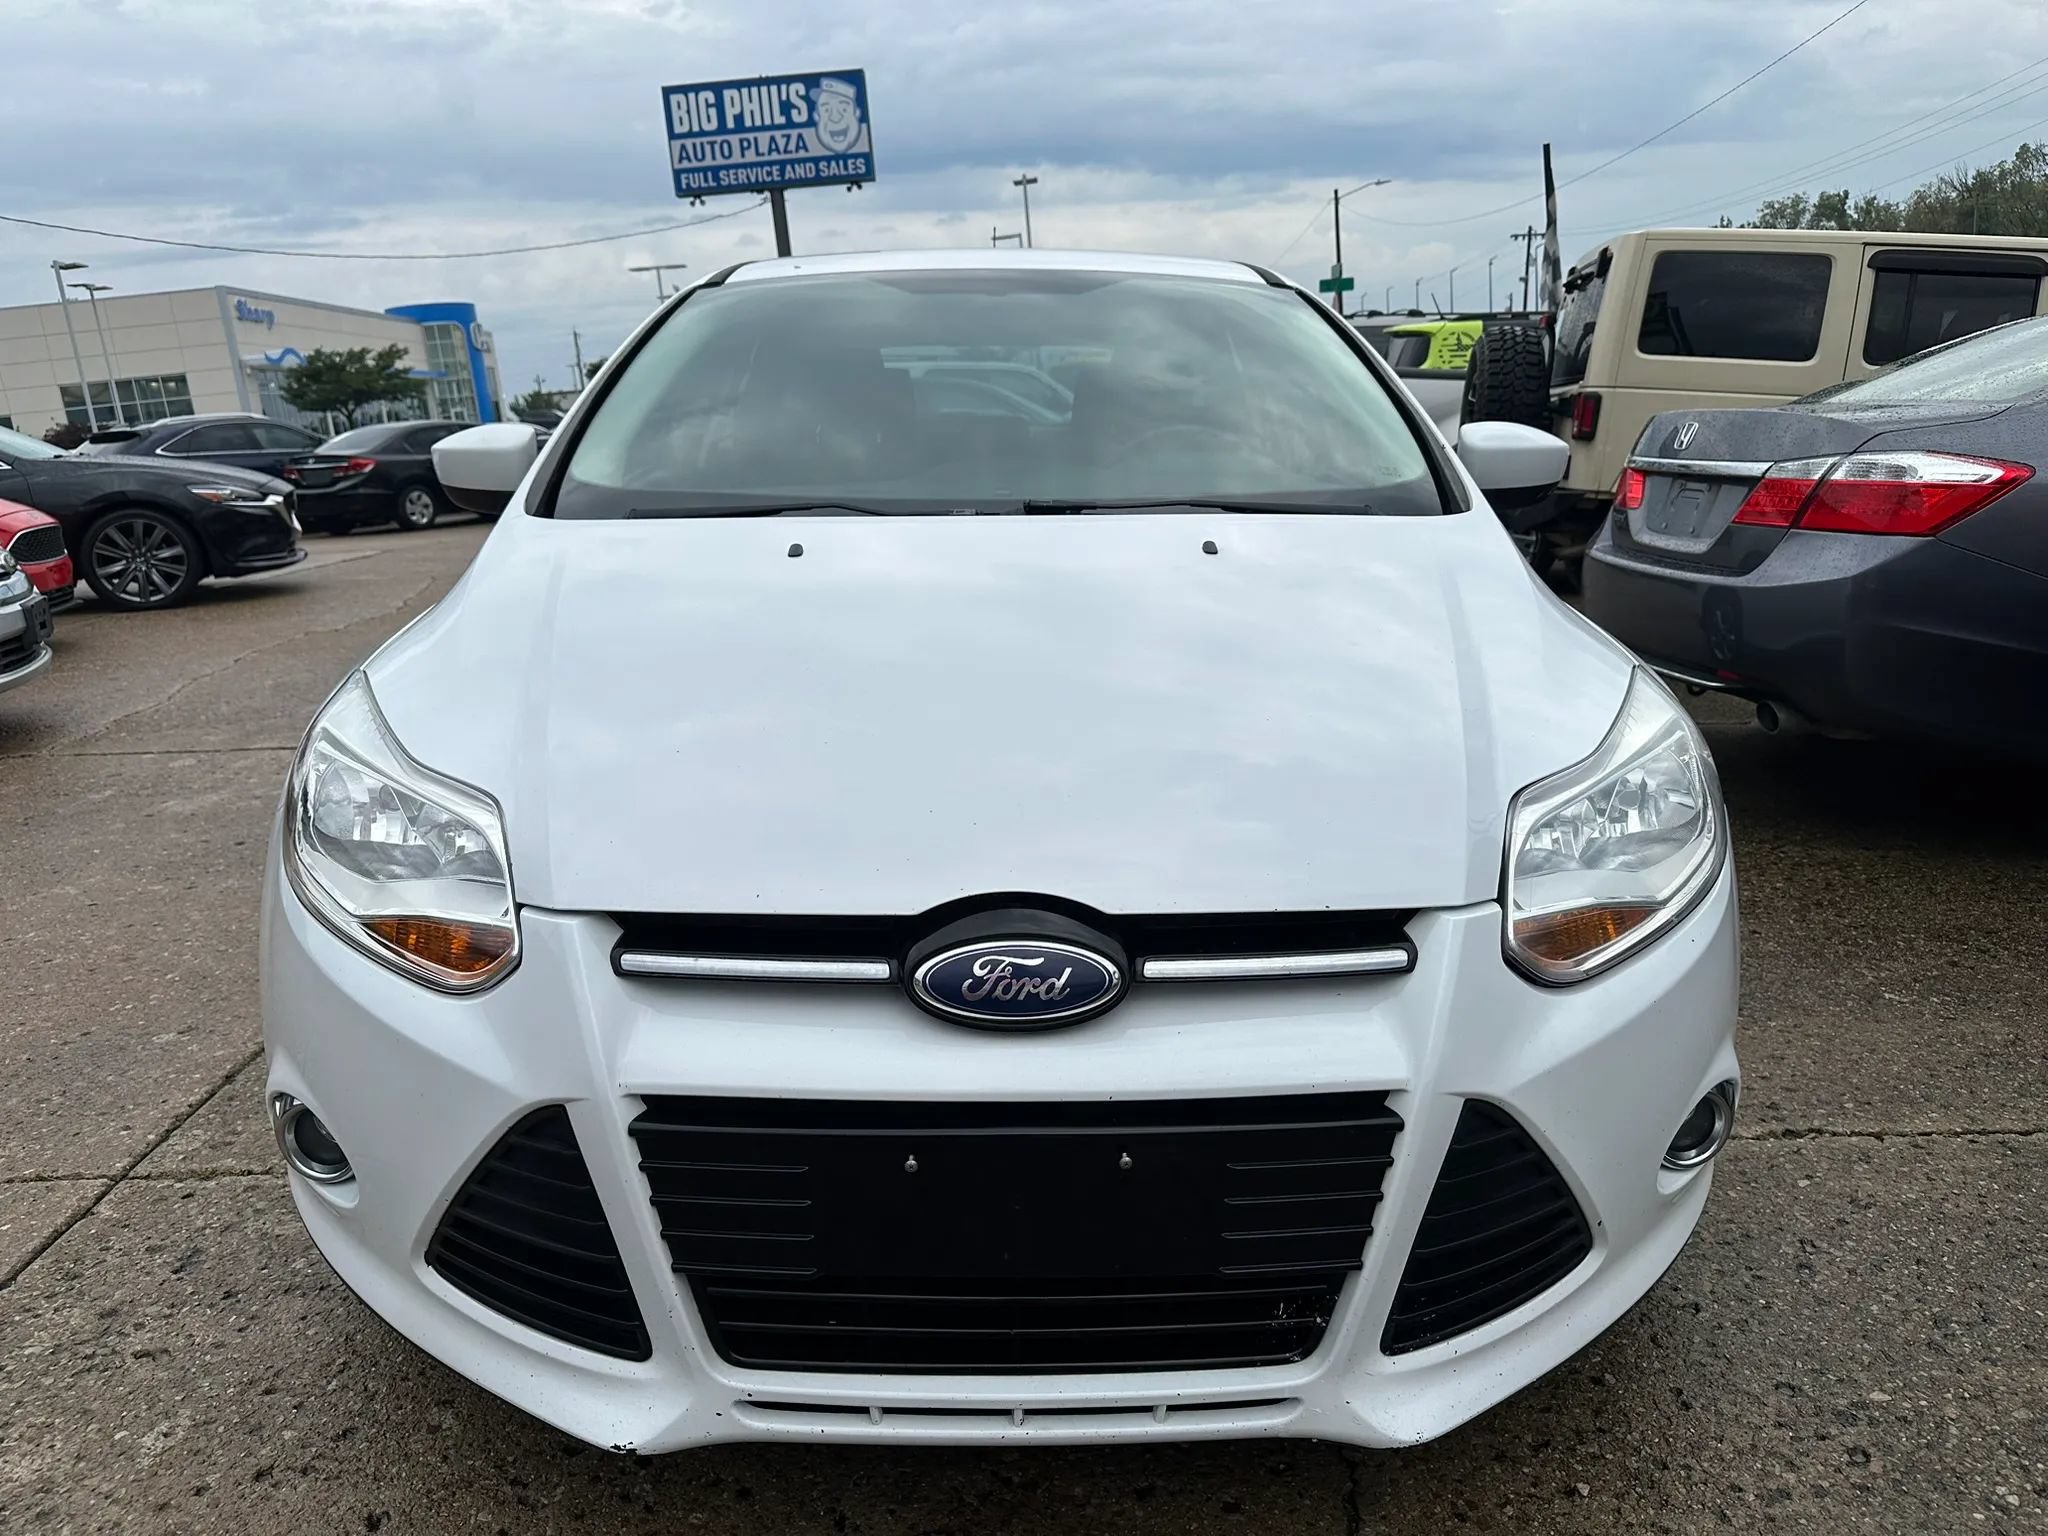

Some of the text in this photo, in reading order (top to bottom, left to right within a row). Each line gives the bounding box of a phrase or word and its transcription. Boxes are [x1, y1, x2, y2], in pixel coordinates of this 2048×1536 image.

[669, 82, 809, 134] BIG PHIL'S
[677, 132, 810, 164] AUTO PLAZA
[680, 158, 867, 190] FULL SERVICE AND SALES
[961, 954, 1073, 1001] Ford
